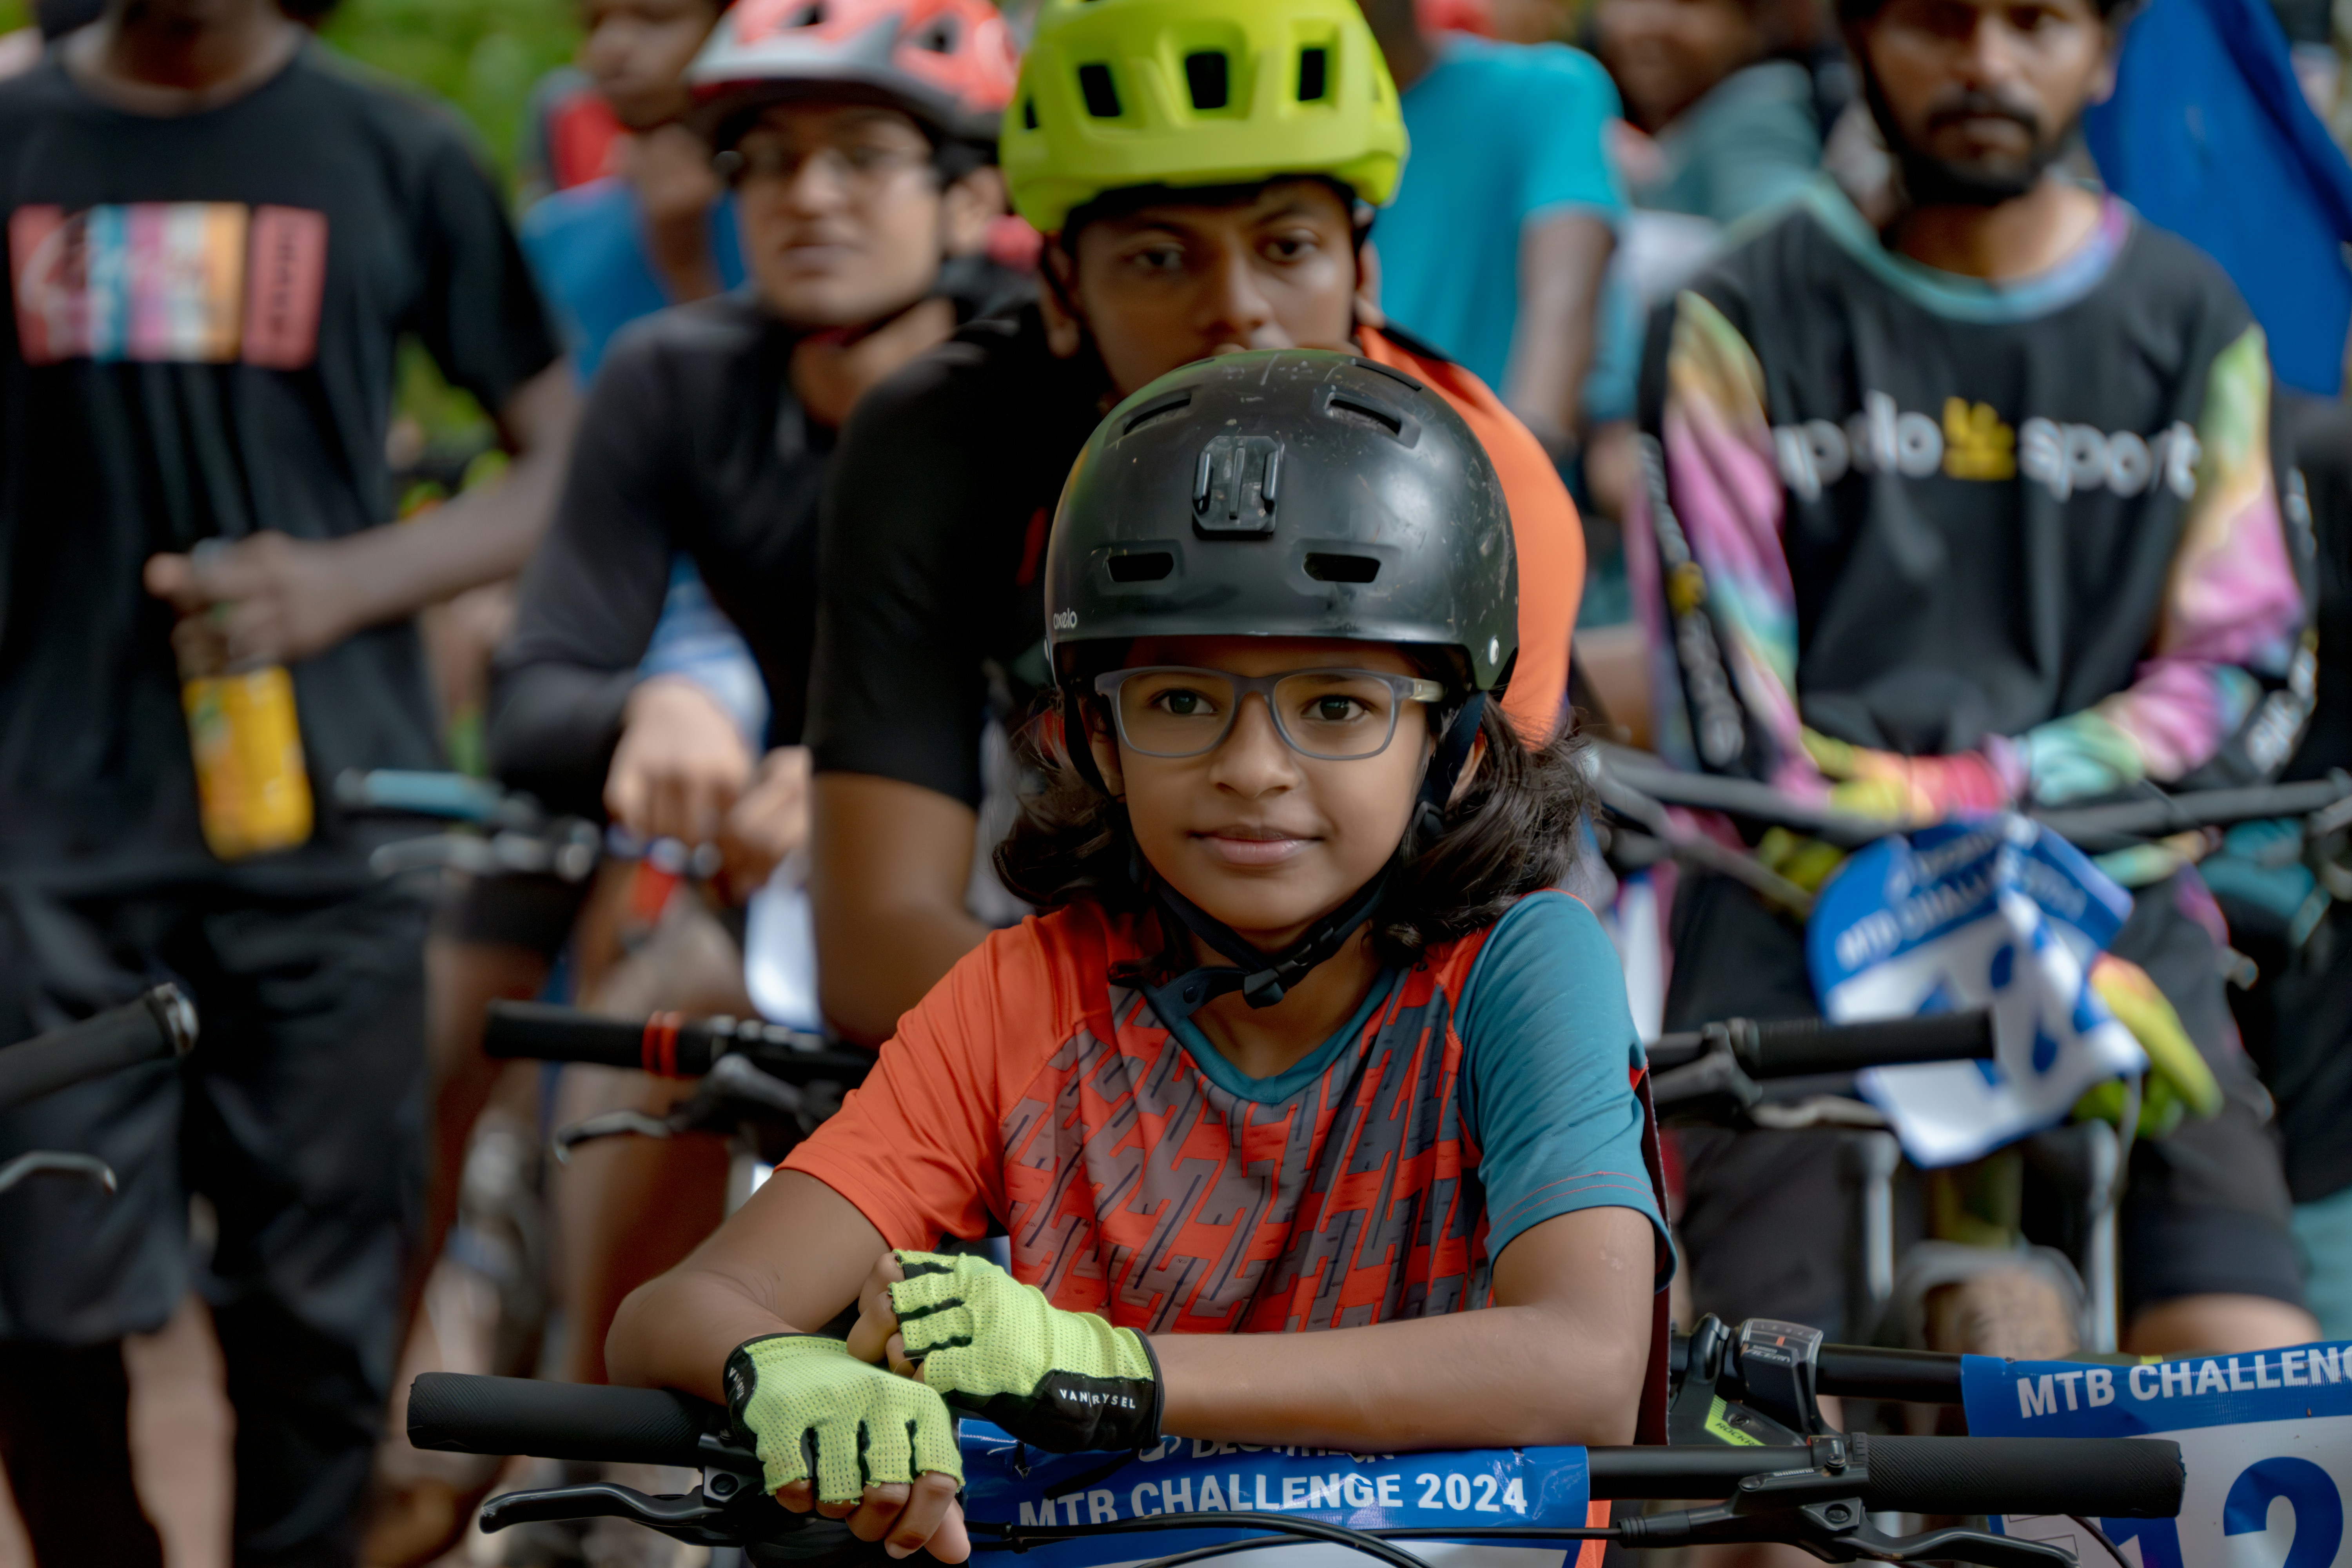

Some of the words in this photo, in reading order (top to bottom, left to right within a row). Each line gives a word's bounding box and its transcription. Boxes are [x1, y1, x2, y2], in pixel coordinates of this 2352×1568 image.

[1053, 607, 1077, 630] oxelo
[2016, 1368, 2115, 1419] MTB
[1131, 1473, 1403, 1518] CHALLENGE
[1416, 1473, 1528, 1514] 2024
